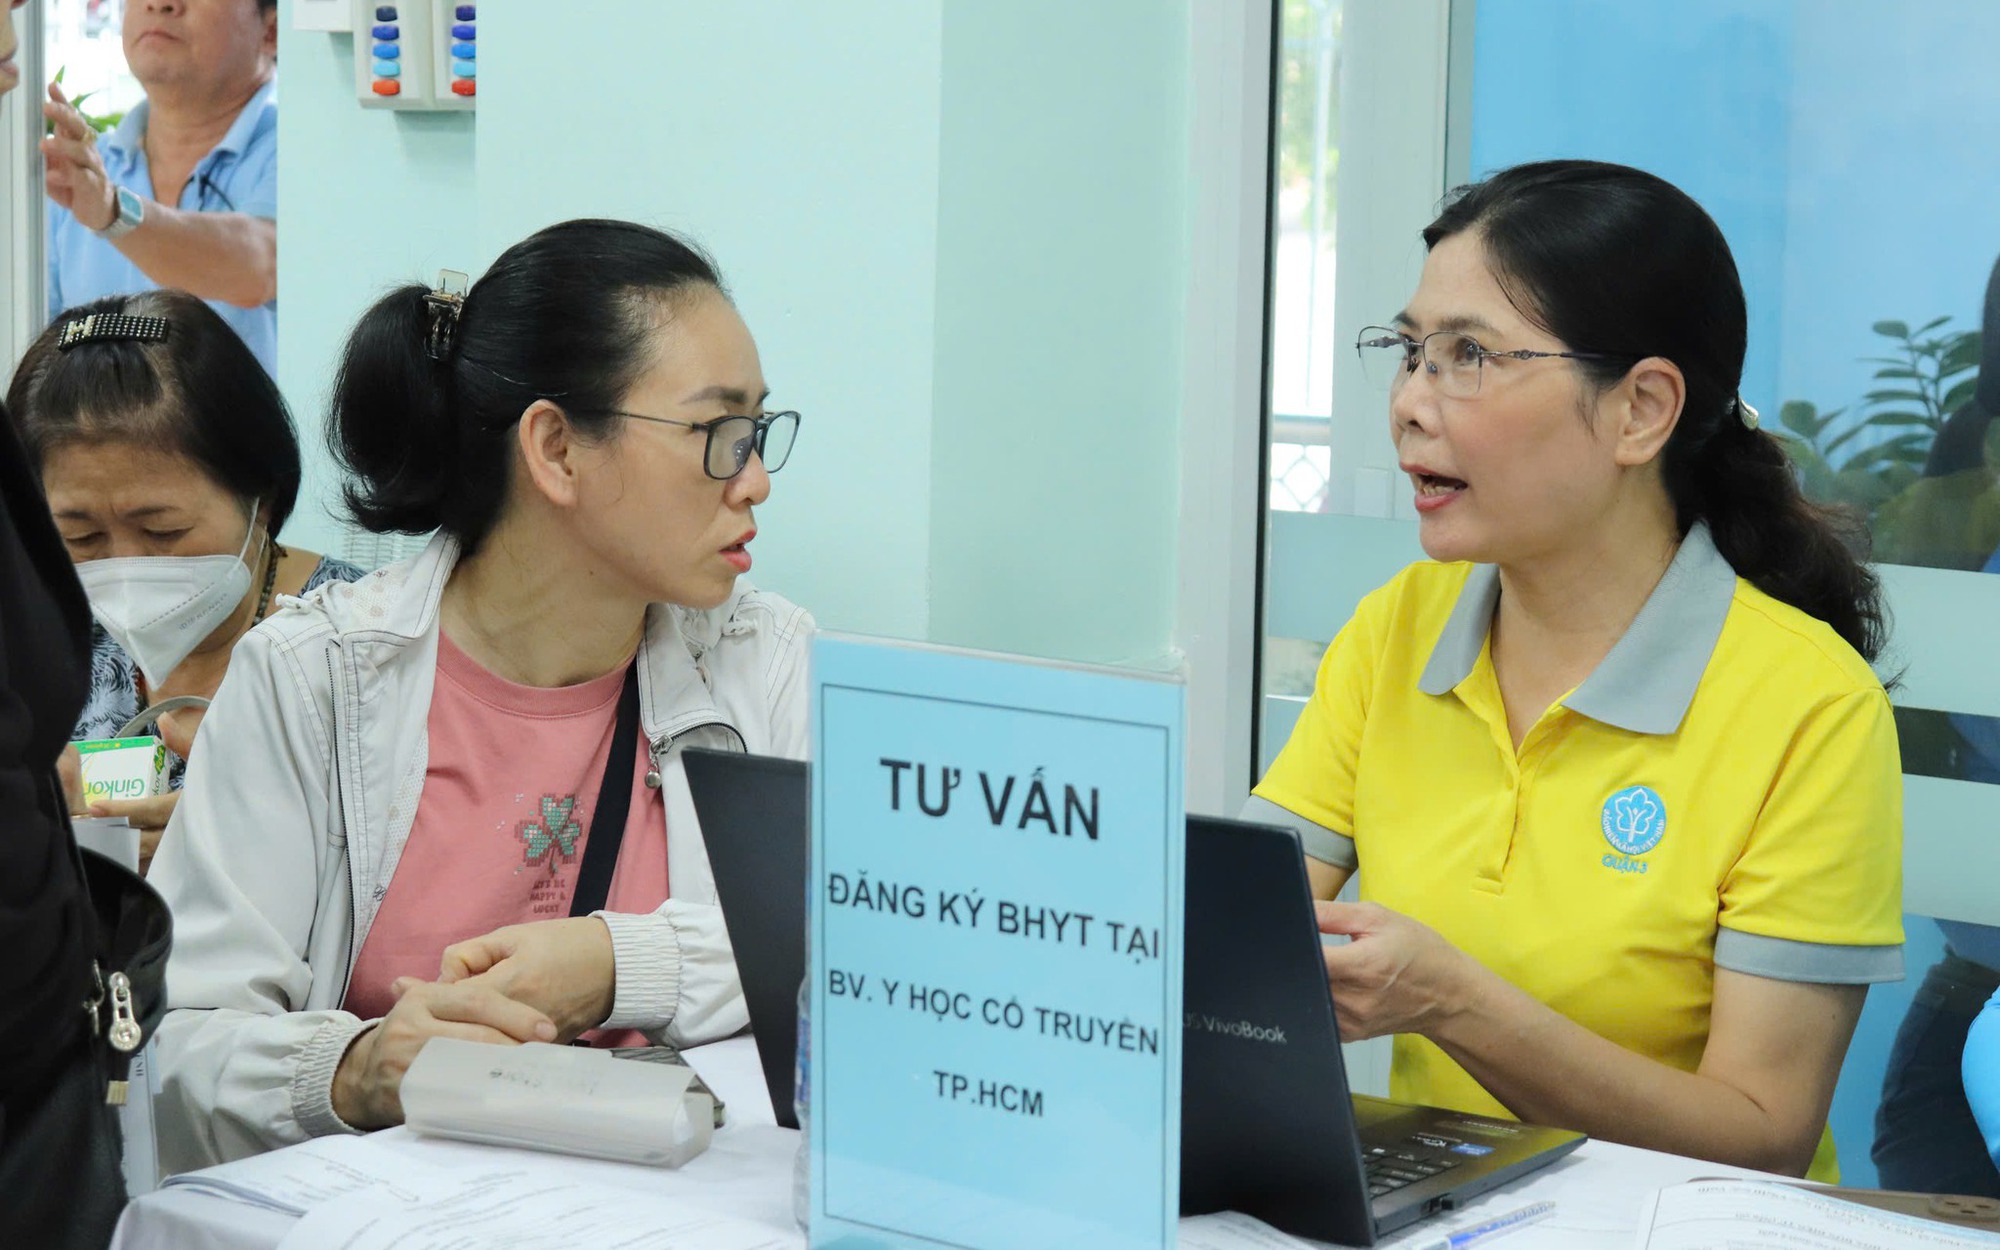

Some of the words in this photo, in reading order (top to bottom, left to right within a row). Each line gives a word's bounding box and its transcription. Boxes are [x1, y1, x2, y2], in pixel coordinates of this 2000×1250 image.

[880, 758, 961, 817] TƯ
[979, 766, 1099, 841] VẤN
[828, 869, 925, 918] ĐĂNG
[939, 887, 985, 928] KÝ
[998, 900, 1094, 947] BHYT
[1106, 921, 1158, 965] TẠI
[829, 970, 873, 1001] BV.
[882, 979, 899, 1006] Y
[909, 984, 971, 1022] HỌC
[933, 1070, 1045, 1117] TP.HCM
